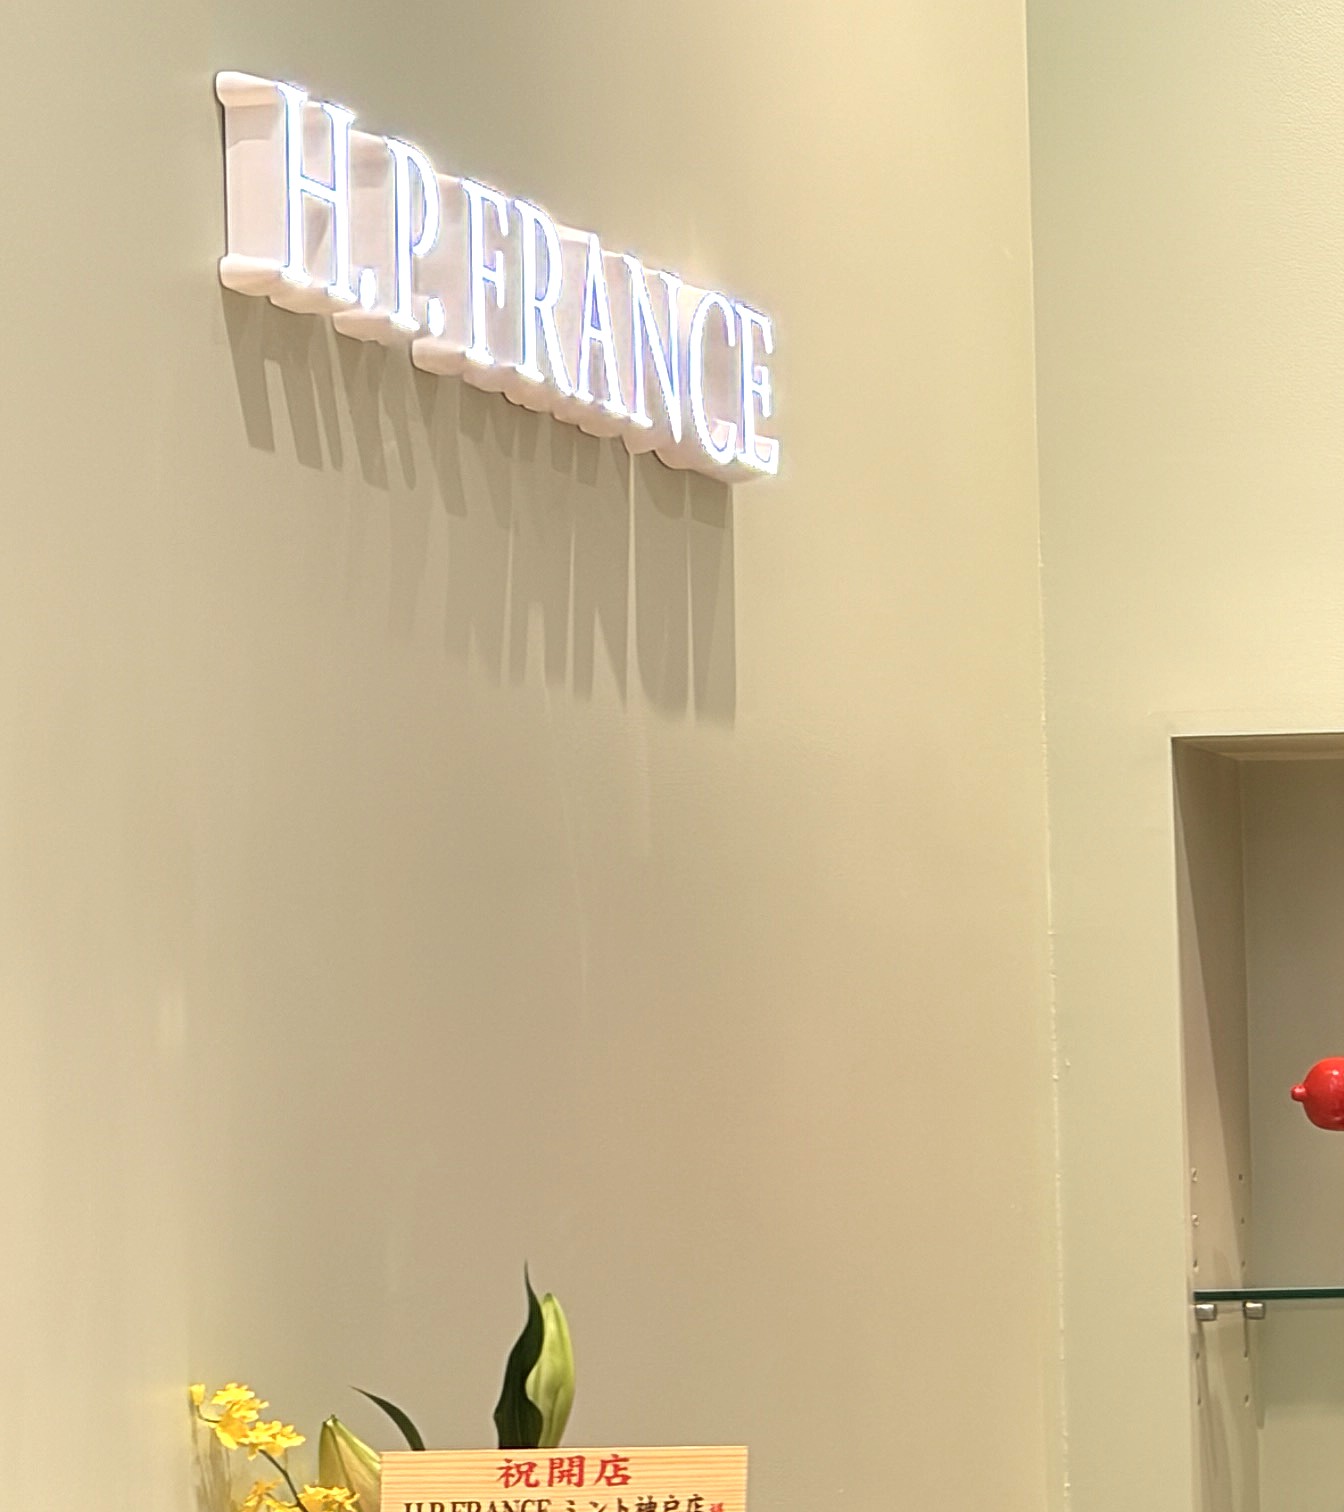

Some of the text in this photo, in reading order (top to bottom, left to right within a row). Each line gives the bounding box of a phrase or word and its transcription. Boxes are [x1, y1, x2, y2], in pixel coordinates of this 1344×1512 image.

[275, 80, 782, 478] H.P.FRANCE
[497, 1454, 632, 1489] 祝開店
